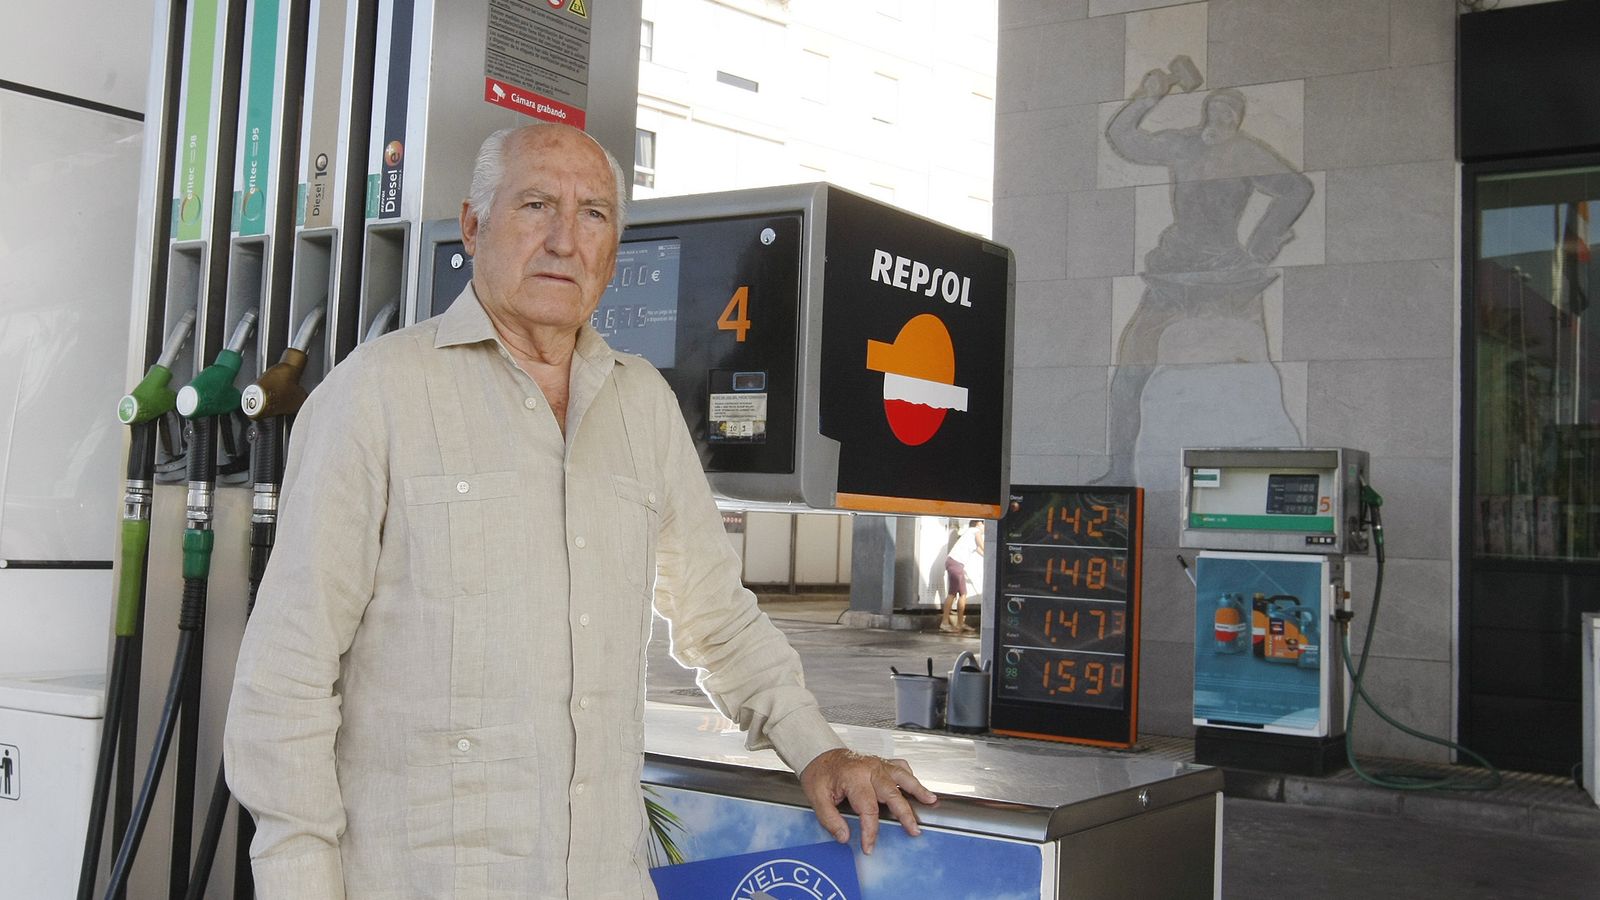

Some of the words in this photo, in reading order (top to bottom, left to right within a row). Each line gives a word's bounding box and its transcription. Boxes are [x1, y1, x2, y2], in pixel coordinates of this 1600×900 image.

[511, 93, 536, 108] Cámara
[536, 104, 566, 119] grabando
[252, 128, 259, 141] 95
[315, 153, 328, 178] 10
[313, 184, 322, 216] Diesel
[385, 170, 398, 213] Diesel
[870, 249, 972, 307] REPSOL
[717, 286, 752, 342] 4
[246, 398, 256, 409] 10
[1320, 497, 1330, 512] 5
